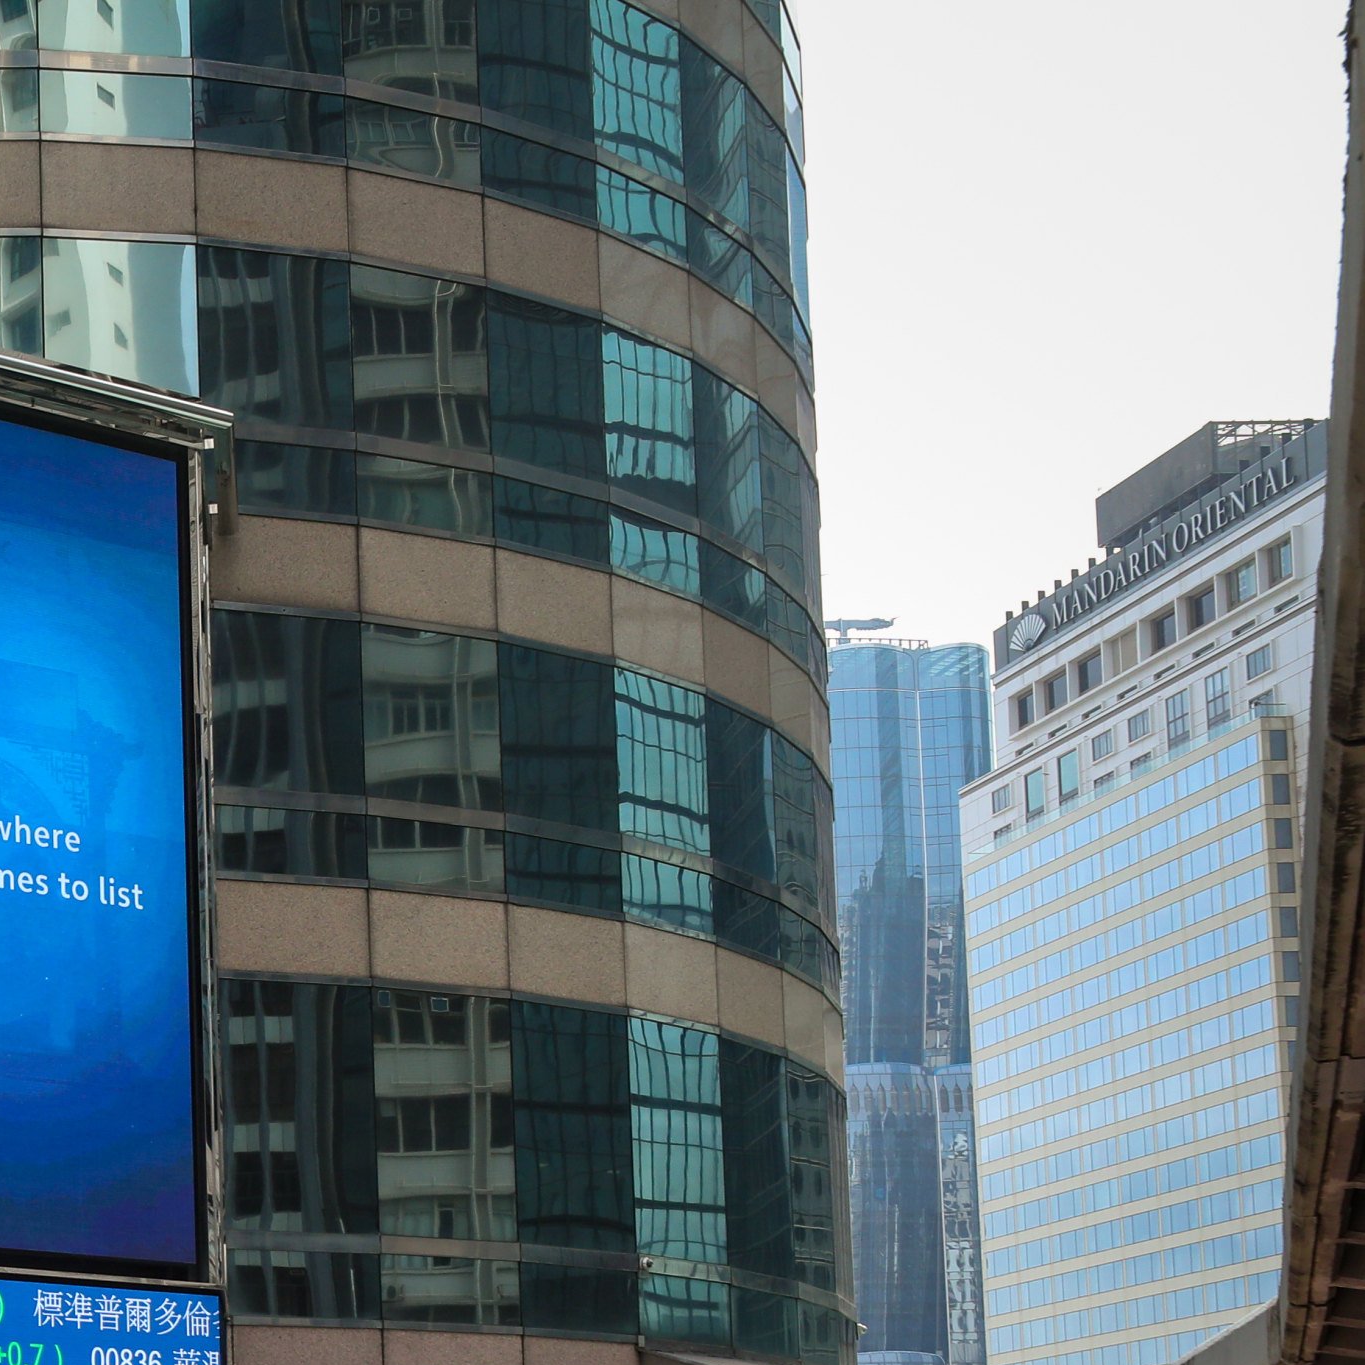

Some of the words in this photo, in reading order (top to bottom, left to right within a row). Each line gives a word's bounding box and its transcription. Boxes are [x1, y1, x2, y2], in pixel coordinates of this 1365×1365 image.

[1051, 533, 1168, 631] MANDARIN
[1172, 456, 1295, 553] ORIENTAL
[58, 873, 89, 901] to
[99, 876, 144, 910] list
[33, 1288, 220, 1339] 標準普爾多倫
